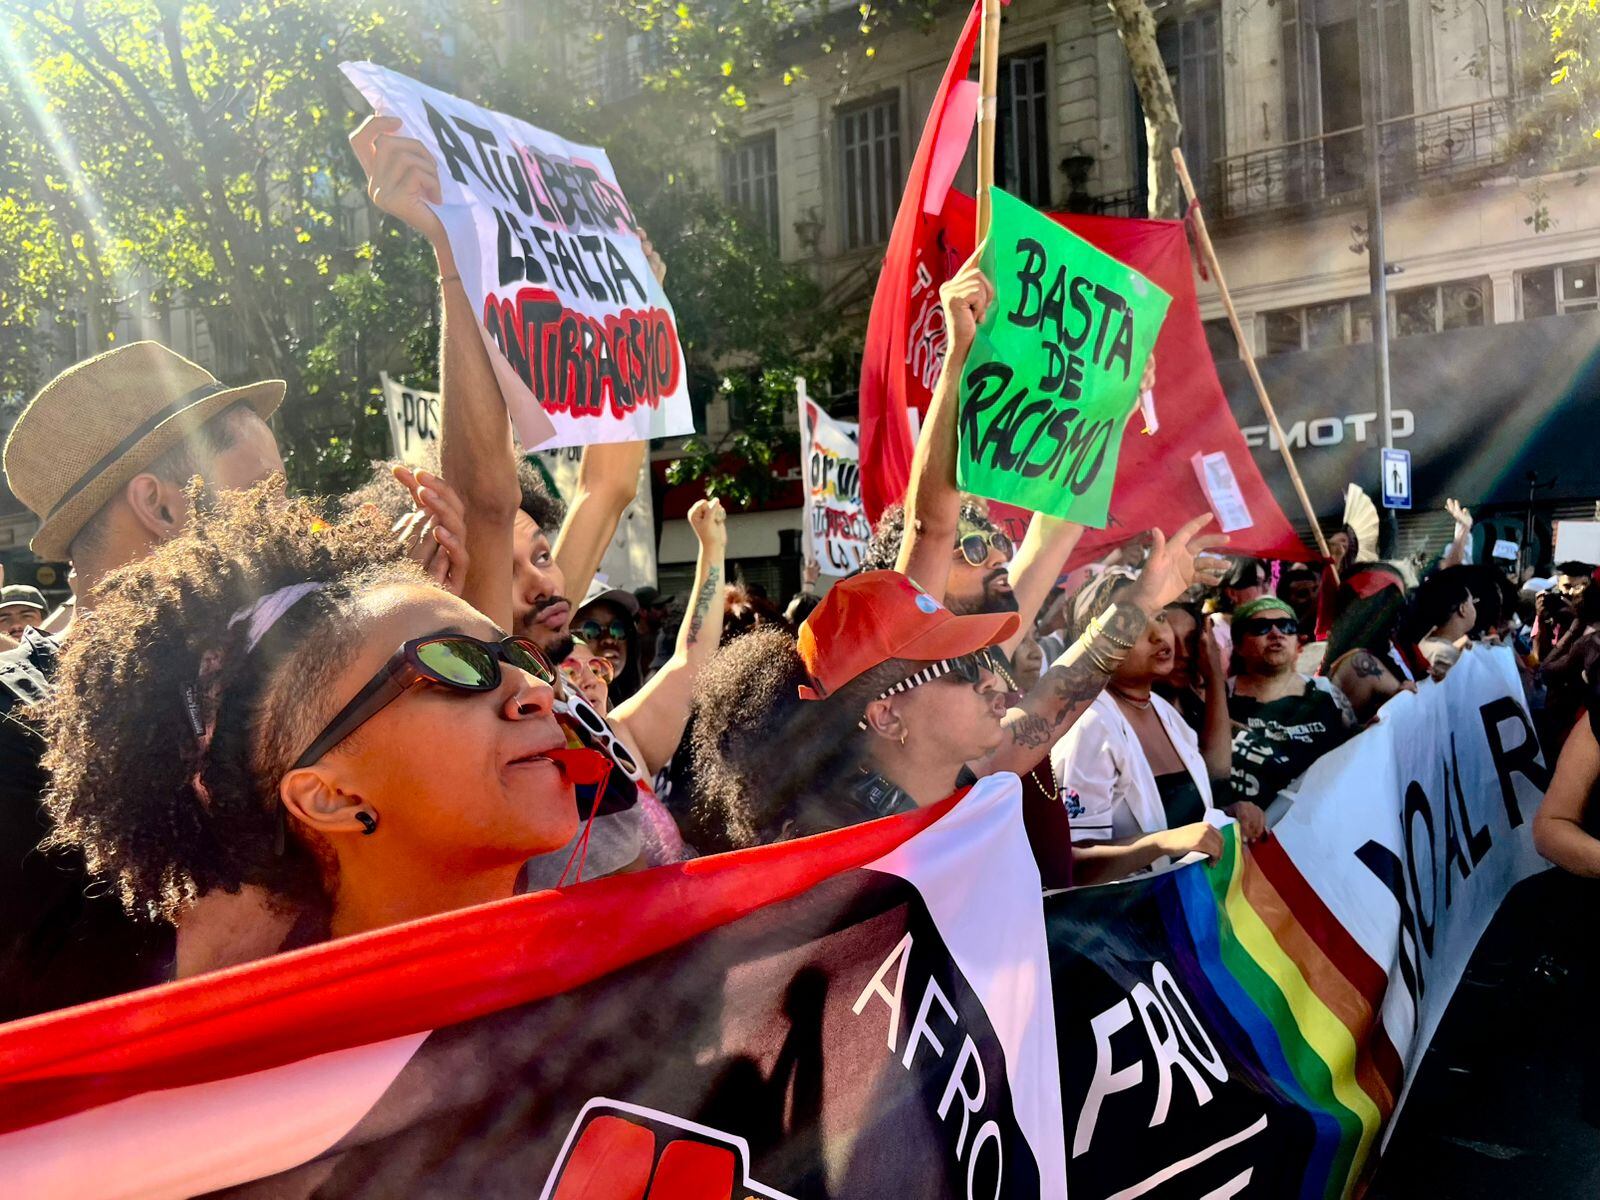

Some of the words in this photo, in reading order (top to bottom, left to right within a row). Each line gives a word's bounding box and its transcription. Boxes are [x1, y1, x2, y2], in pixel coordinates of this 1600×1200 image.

[421, 98, 494, 193] A
[512, 144, 639, 234] LIBERTAD
[492, 207, 548, 287] LE
[530, 226, 648, 305] FALTA
[1007, 238, 1134, 381] BASTA
[960, 362, 1114, 496] RACISMO
[1039, 341, 1084, 400] DE
[852, 931, 1003, 1199] AFRO
